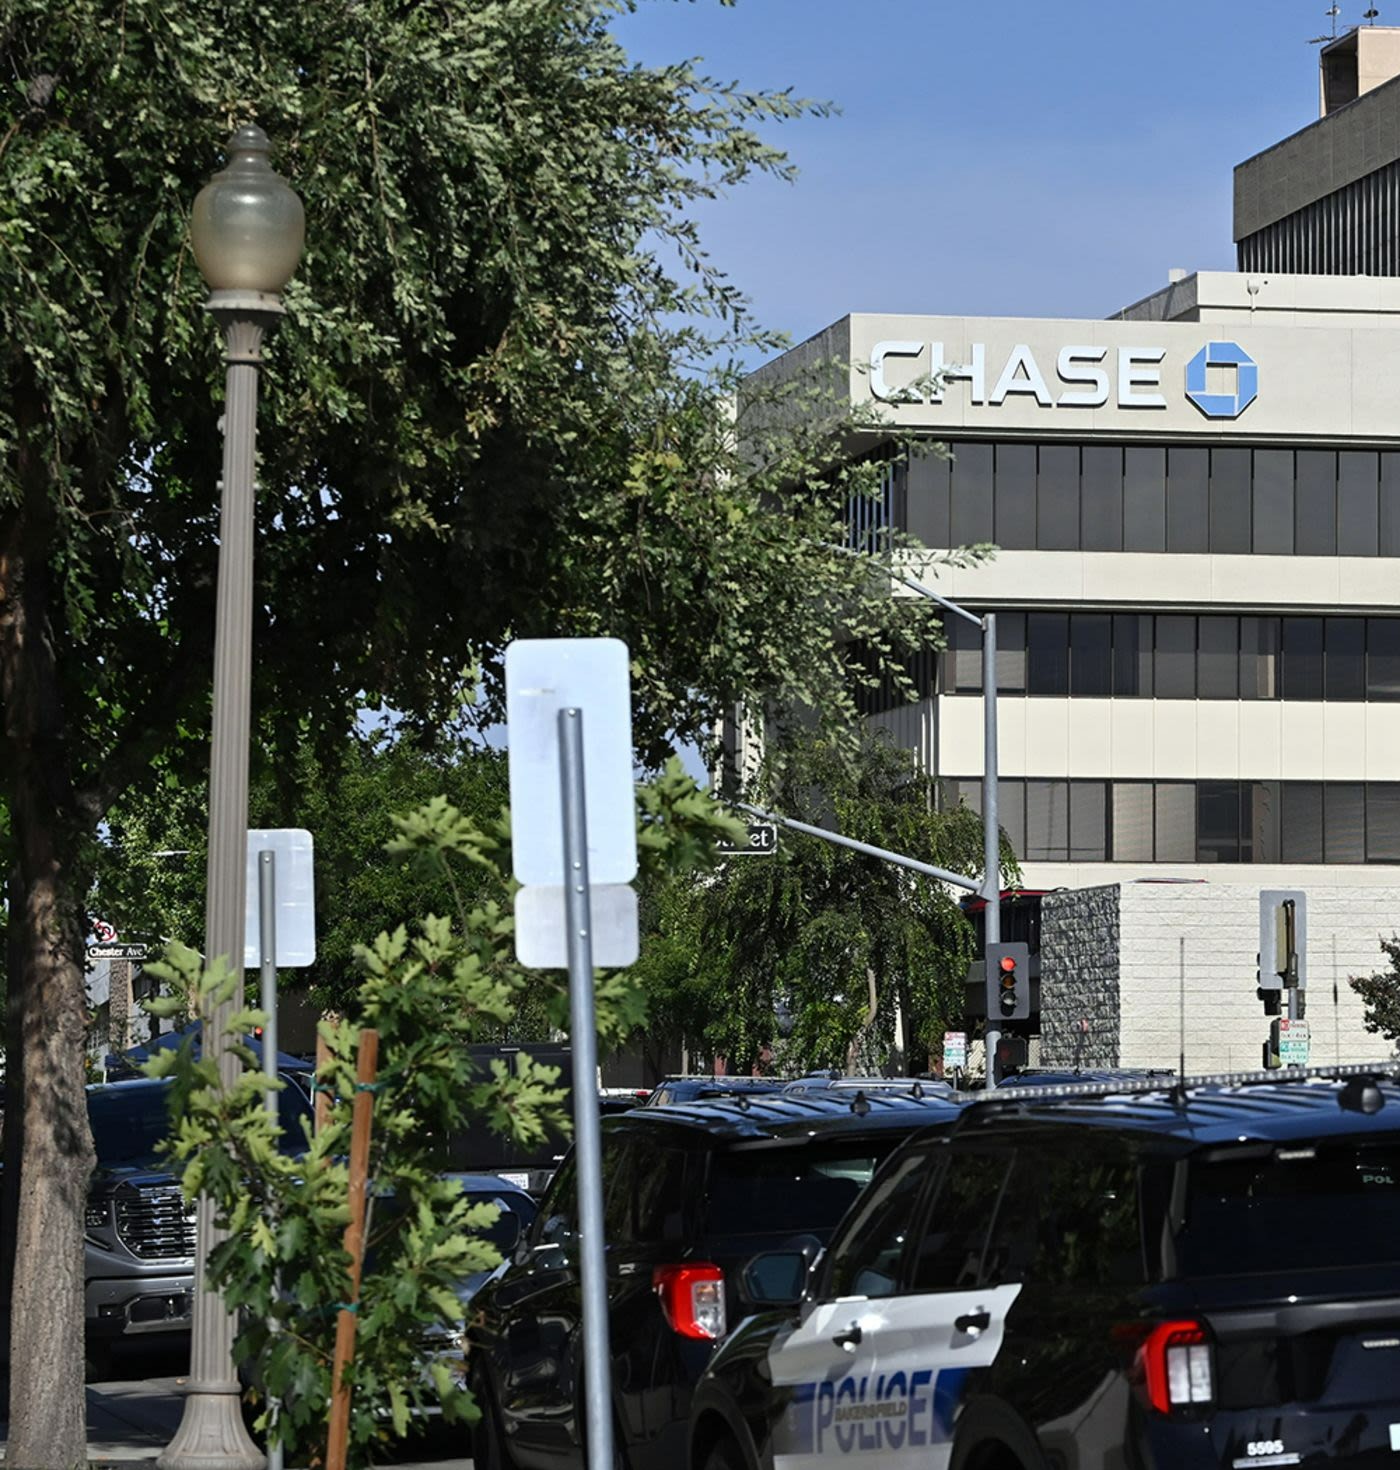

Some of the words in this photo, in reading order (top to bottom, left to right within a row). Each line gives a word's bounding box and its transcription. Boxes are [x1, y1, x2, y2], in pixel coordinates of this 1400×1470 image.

[869, 340, 1167, 409] CHASE
[89, 947, 124, 956] Chester
[126, 947, 144, 956] Ave
[816, 1370, 934, 1454] POLICE
[834, 1401, 908, 1422] BAKERSFIELD
